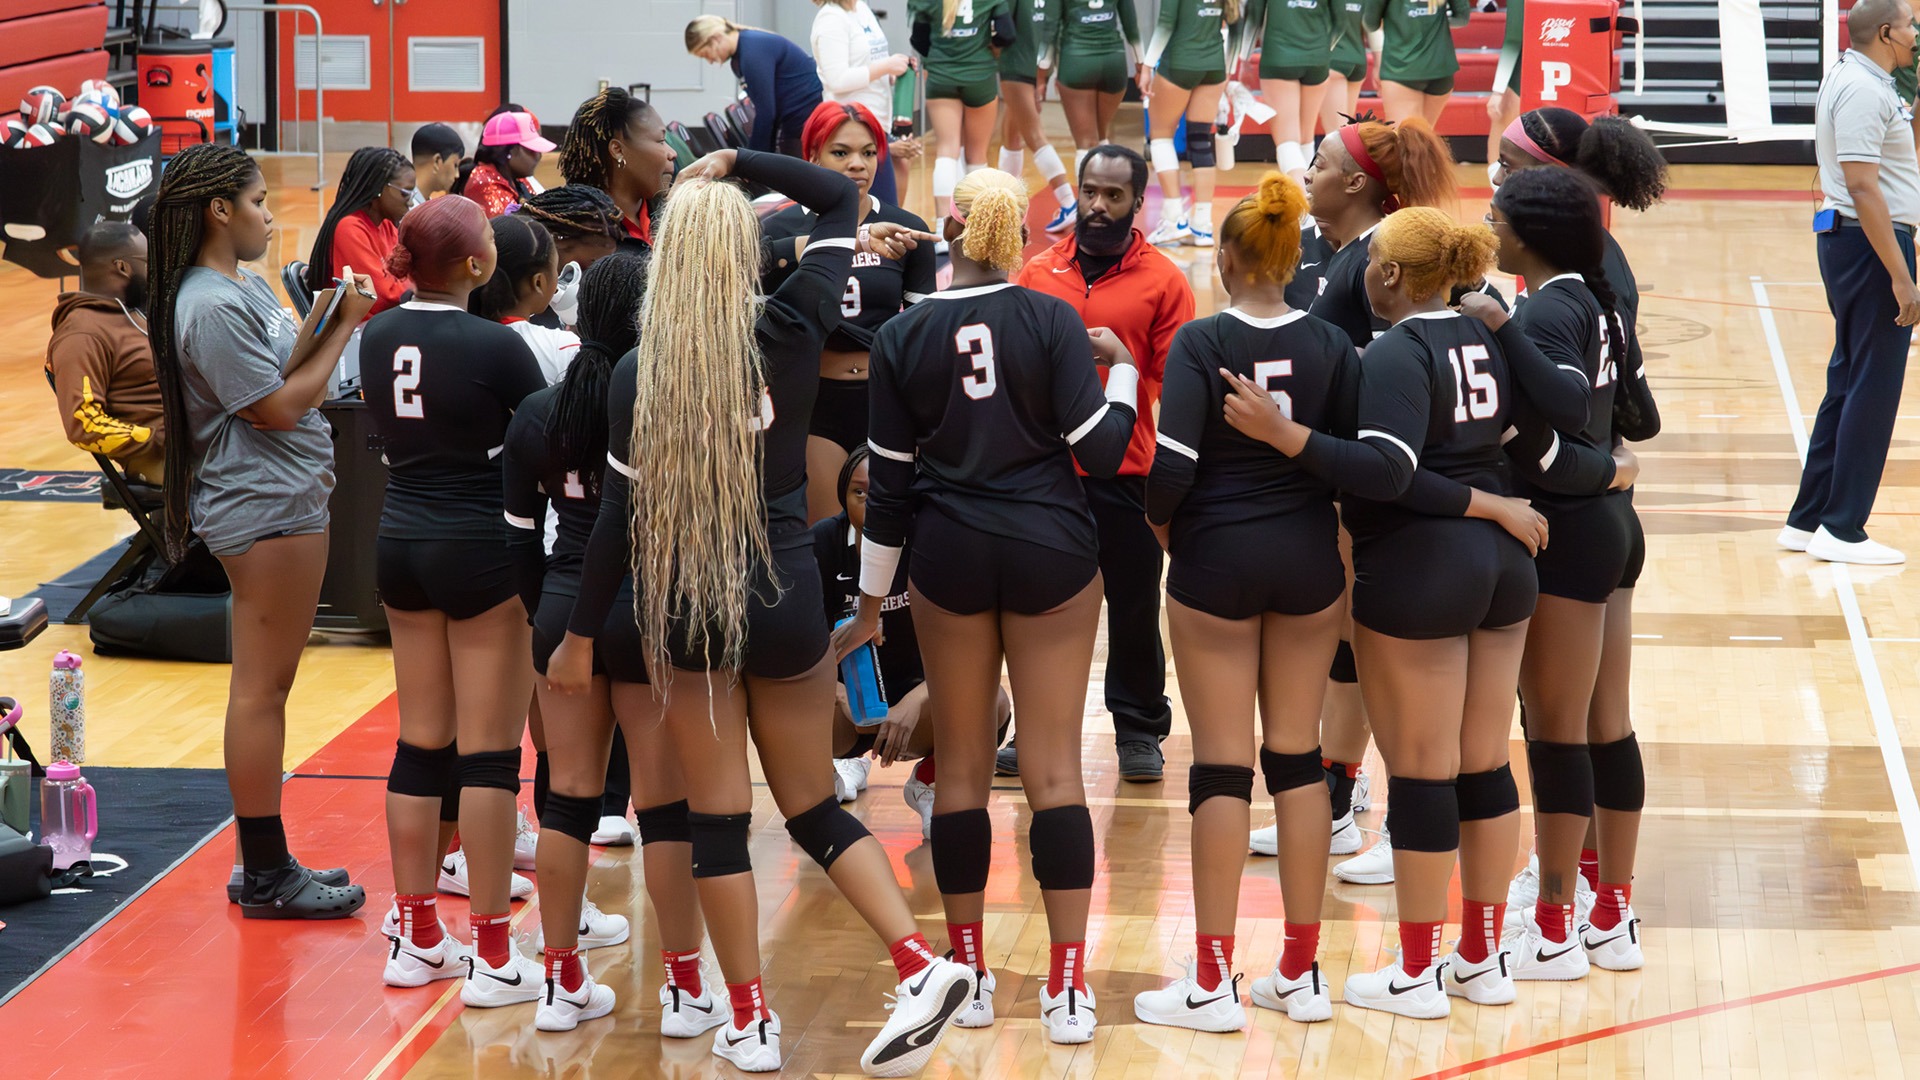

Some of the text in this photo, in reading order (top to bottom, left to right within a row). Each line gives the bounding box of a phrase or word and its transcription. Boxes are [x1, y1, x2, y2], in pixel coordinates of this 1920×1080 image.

[956, 0, 974, 24] 4
[1541, 61, 1572, 101] P
[393, 345, 424, 419] 2
[954, 322, 997, 401] 3
[1254, 359, 1293, 421] 5
[1448, 344, 1499, 424] 15
